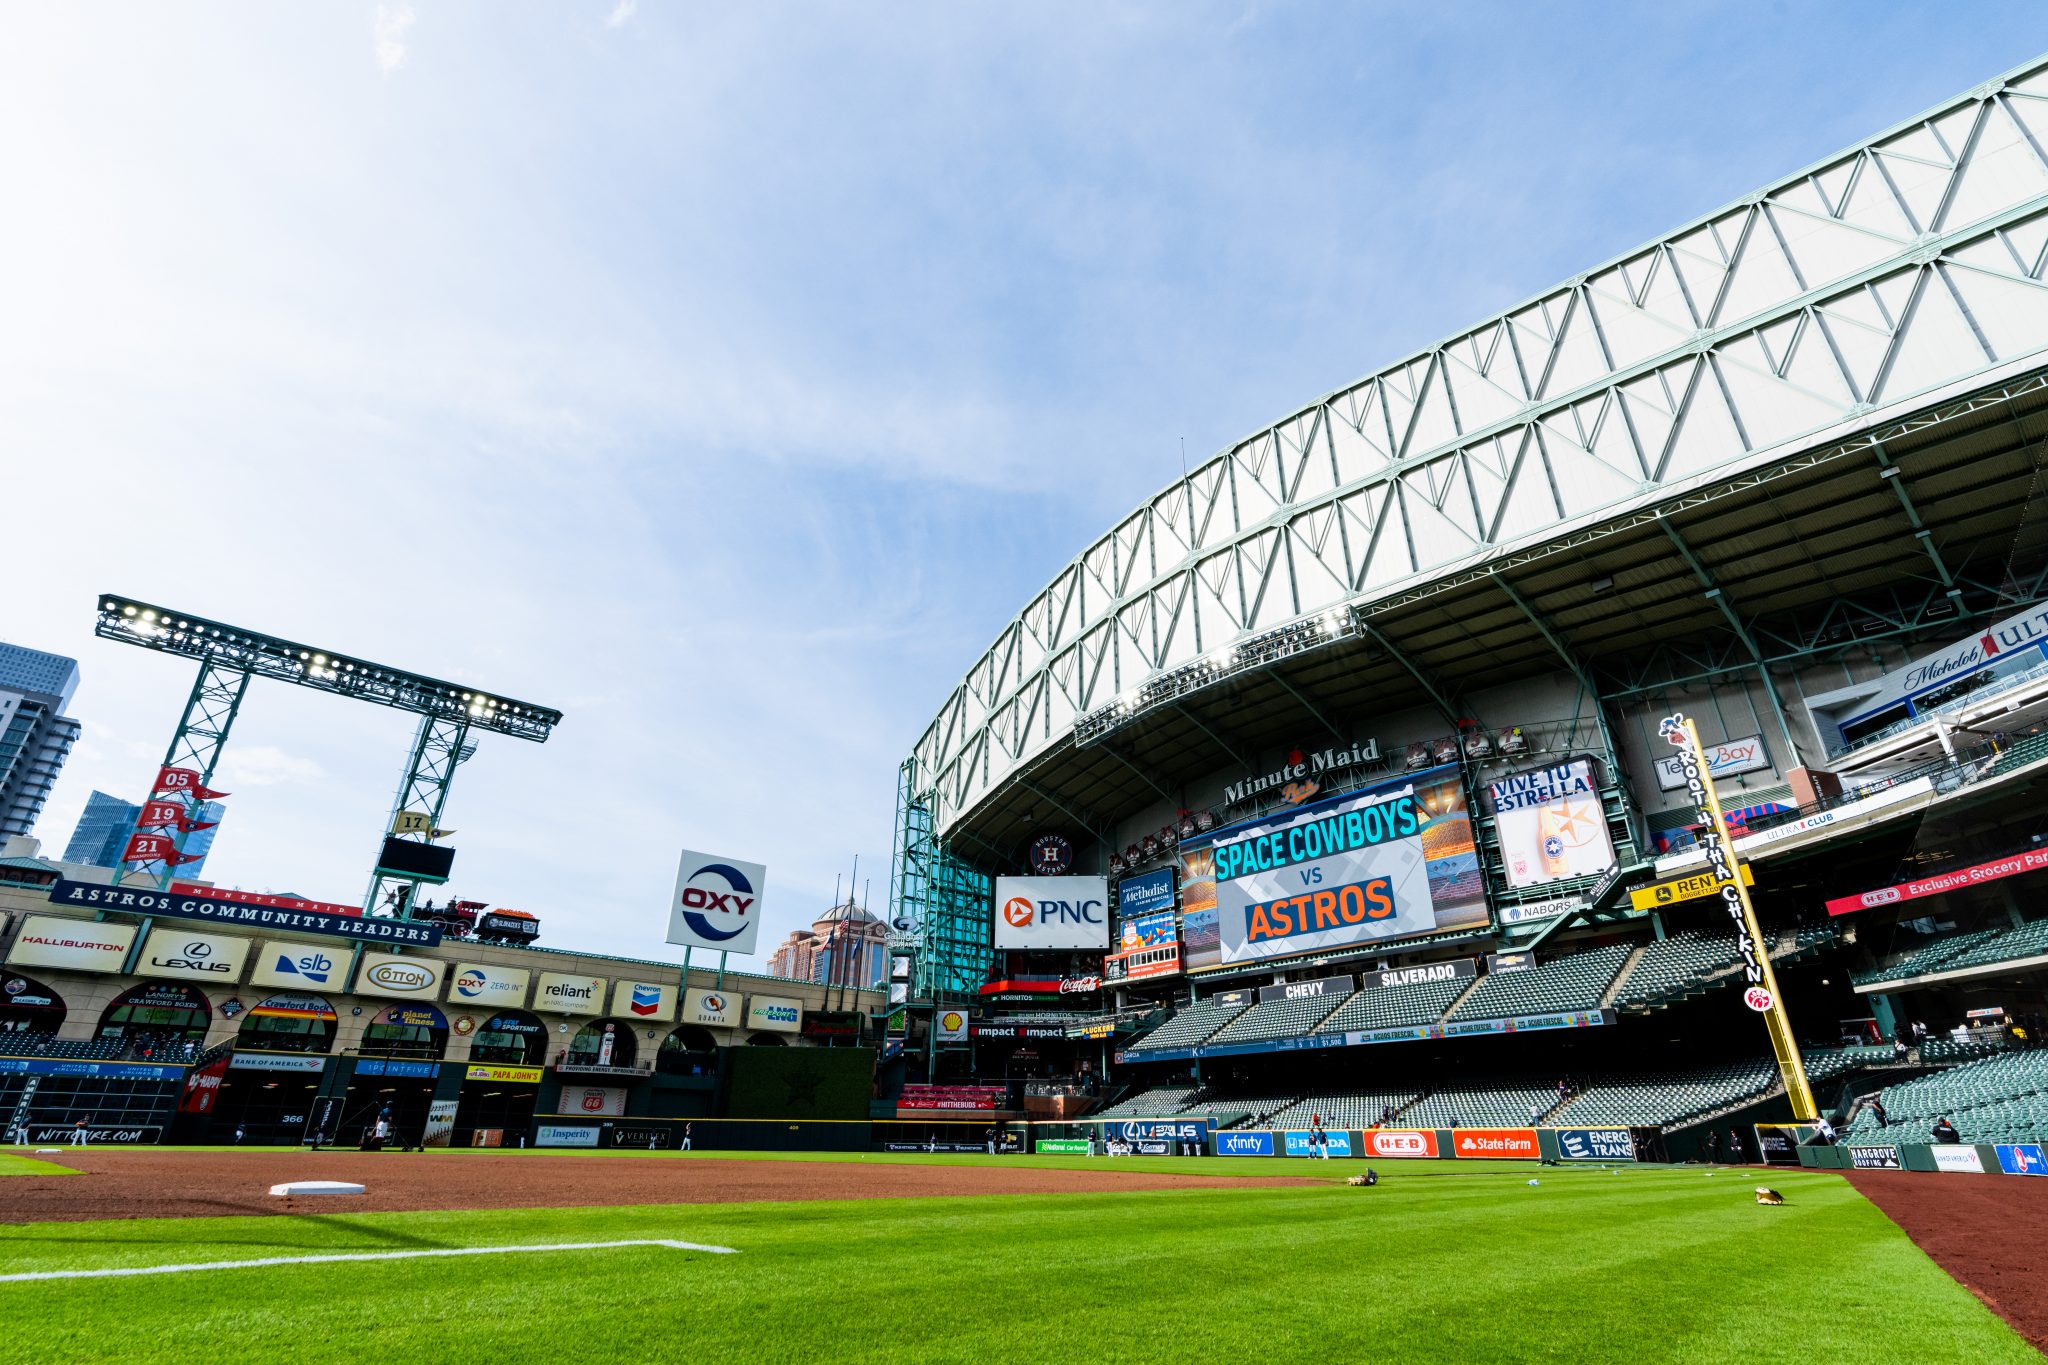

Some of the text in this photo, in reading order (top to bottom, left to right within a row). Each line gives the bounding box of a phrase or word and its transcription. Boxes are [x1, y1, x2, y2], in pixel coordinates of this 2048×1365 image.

[1904, 612, 2048, 691] Michelob ULT
[1661, 745, 1755, 775] Tes Bay
[1224, 738, 1380, 806] Minute Maid
[1543, 765, 1571, 783] TU
[165, 773, 189, 786] 05
[152, 807, 175, 820] 19
[1697, 810, 1713, 829] 4
[1807, 813, 1834, 827] CLUB
[404, 817, 423, 829] 17
[1036, 835, 1068, 847] HOUSTON
[1216, 798, 1417, 880] SPACE COWBOYS
[136, 840, 158, 853] 21
[1044, 848, 1058, 861] H
[1703, 833, 1733, 881] THA
[1037, 863, 1066, 873] ASTROS
[1909, 872, 1967, 895] Exclusive
[1970, 859, 2021, 880] Grocery
[2025, 853, 2048, 866] Par
[1300, 867, 1323, 885] VS
[1124, 882, 1168, 903] Methodist
[193, 888, 345, 912] MINUTE MAID
[682, 887, 754, 915] OXY
[69, 887, 430, 941] ASTROS COMMUNITY LEADERS
[1038, 900, 1103, 924] PNC
[1248, 879, 1392, 941] ASTROS
[1524, 900, 1571, 917] NABORS
[1722, 887, 1762, 982] CHIKIN
[22, 936, 124, 952] HALLIBURTON
[151, 957, 232, 972] LEXUS
[299, 953, 332, 972] slb
[376, 967, 426, 986] COTTON
[1381, 964, 1455, 987] SILVERADO
[458, 978, 510, 991] OXY ZERO
[634, 984, 661, 993] Chevron
[1286, 982, 1324, 999] CHEVY
[145, 992, 187, 1000] LANDRY'S
[545, 984, 592, 999] reliant
[128, 998, 198, 1009] CRAWFORD BOXES
[265, 1000, 330, 1012] Crawford Bock
[402, 1010, 431, 1019] planet
[698, 1014, 725, 1023] QUANTA
[753, 1008, 792, 1017] FREEPORT
[767, 1006, 798, 1022] LNG
[404, 1017, 435, 1026] fitness
[501, 1024, 540, 1032] SPORTSNET
[978, 1028, 1063, 1038] impact impact
[1081, 1024, 1115, 1035] PLUCKERS
[1192, 1047, 1198, 1057] K
[492, 1070, 538, 1080] PAPA JOHN'S
[6, 1079, 37, 1137] AMERICAN
[585, 1098, 600, 1107] 66
[282, 1115, 303, 1123] 366
[37, 1127, 142, 1141] NITTOIRE.COM
[552, 1129, 591, 1139] Insperity
[627, 1132, 666, 1140] VERIEX
[1589, 1132, 1629, 1144] ENERG
[1047, 1143, 1066, 1151] National
[1226, 1135, 1262, 1152] xfinity
[1477, 1138, 1531, 1150] State Farm
[1592, 1144, 1632, 1157] TRANS
[1851, 1147, 1897, 1158] HARGROVE
[1854, 1159, 1882, 1167] ROOFING
